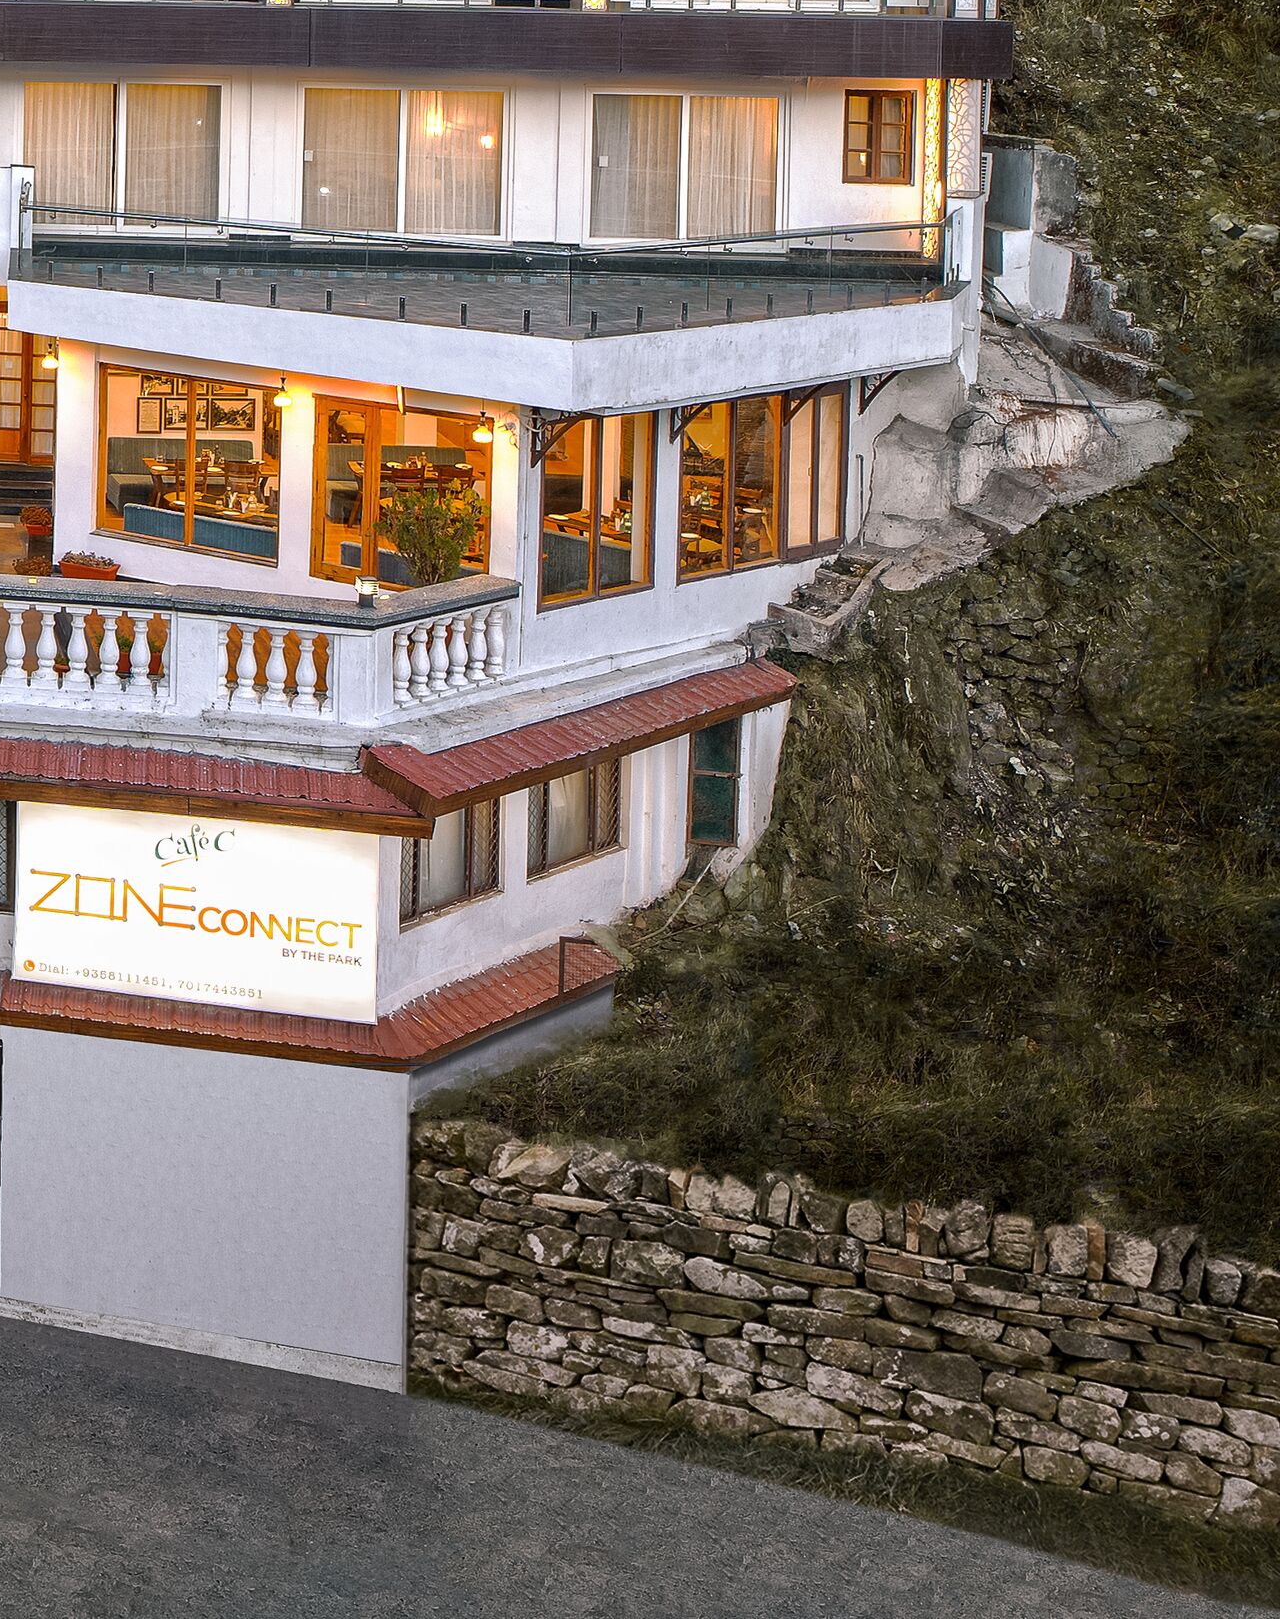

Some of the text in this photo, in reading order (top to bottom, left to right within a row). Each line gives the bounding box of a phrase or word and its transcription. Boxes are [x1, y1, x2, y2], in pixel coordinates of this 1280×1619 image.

[154, 823, 236, 862] Café C
[29, 868, 363, 949] ZONE CONNECT
[39, 962, 69, 975] Dial:
[282, 947, 362, 967] BY THE PARK
